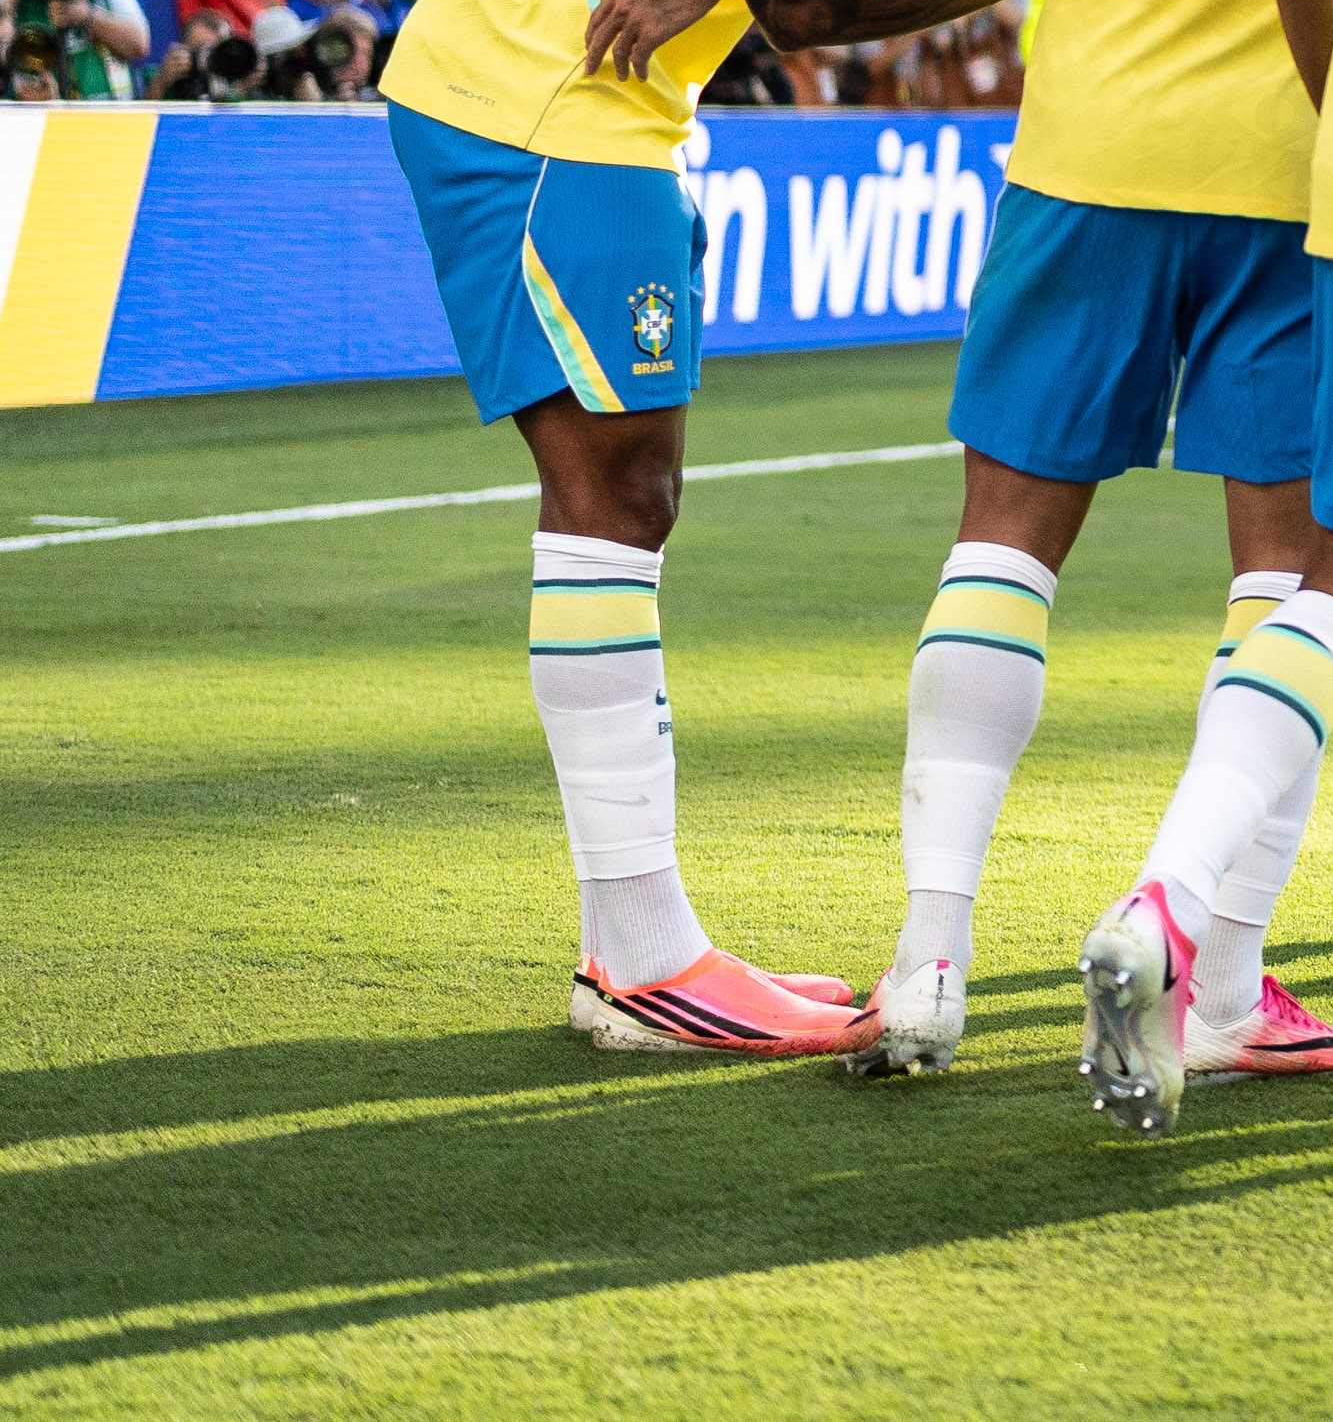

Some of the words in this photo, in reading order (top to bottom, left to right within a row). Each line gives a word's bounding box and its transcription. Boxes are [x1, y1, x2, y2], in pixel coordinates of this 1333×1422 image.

[788, 124, 987, 320] with
[646, 320, 662, 329] CBF
[632, 359, 675, 375] BRASIL
